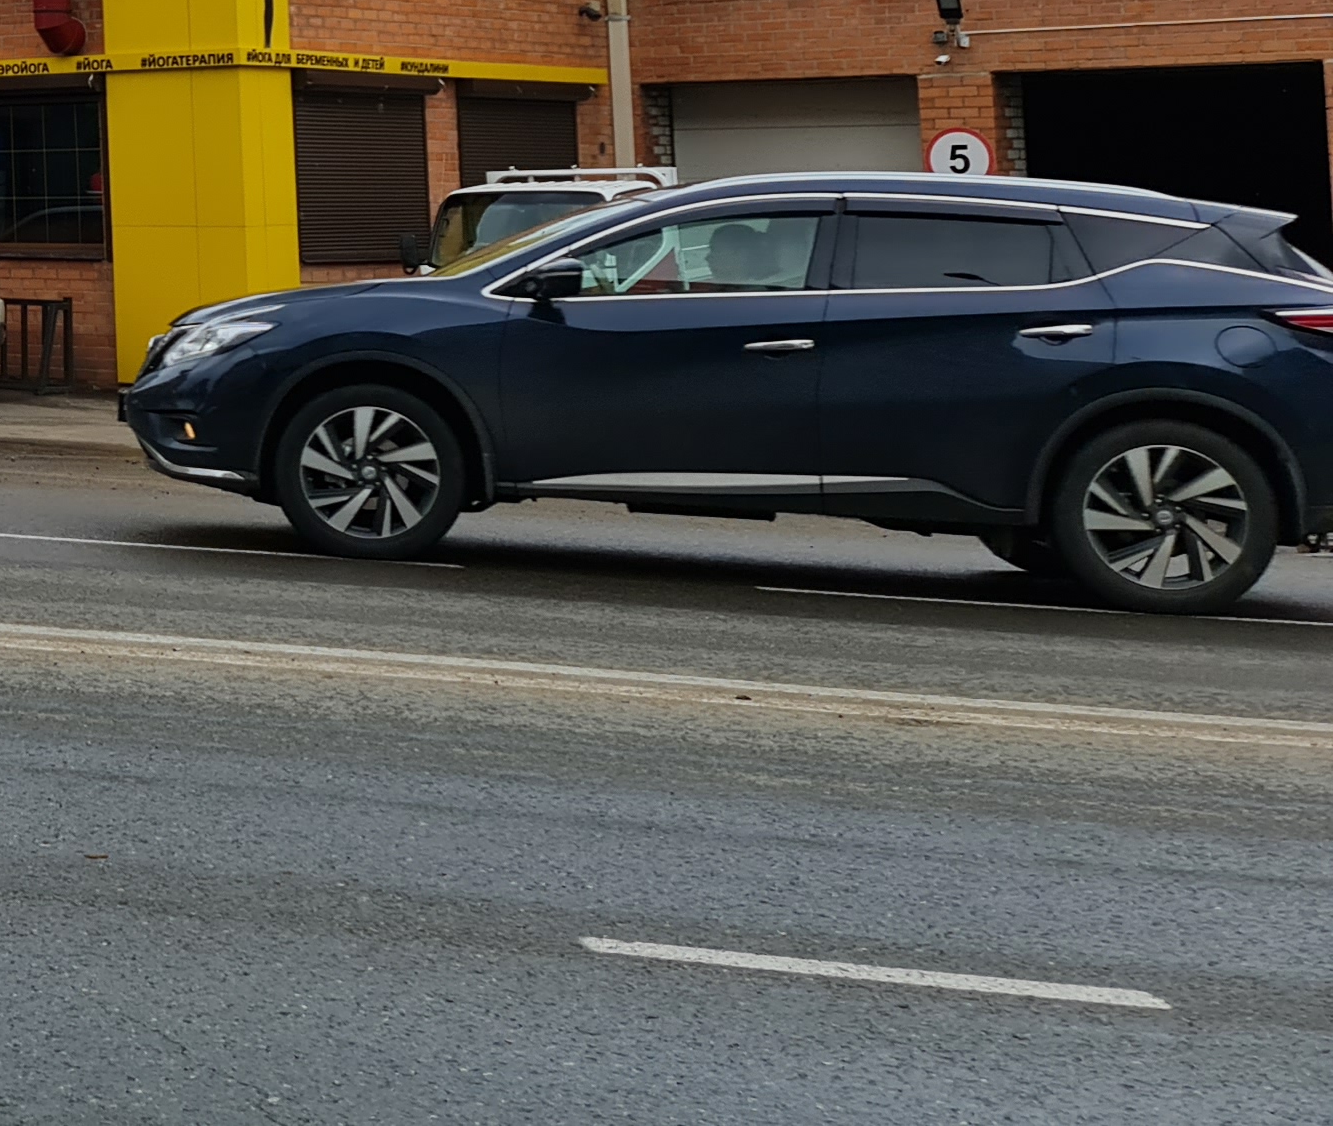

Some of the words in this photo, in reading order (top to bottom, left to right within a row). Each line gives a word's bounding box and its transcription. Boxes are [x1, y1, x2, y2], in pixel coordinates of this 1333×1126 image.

[76, 57, 113, 72] #ЙОГА
[140, 52, 234, 68] #ЙОГАТЕРАПИЯ
[274, 52, 292, 66] ДЛЯ
[296, 54, 350, 69] БЕРЕМЕННЫХ
[360, 56, 386, 72] ДЕТЕЙ
[949, 144, 971, 174] 5
